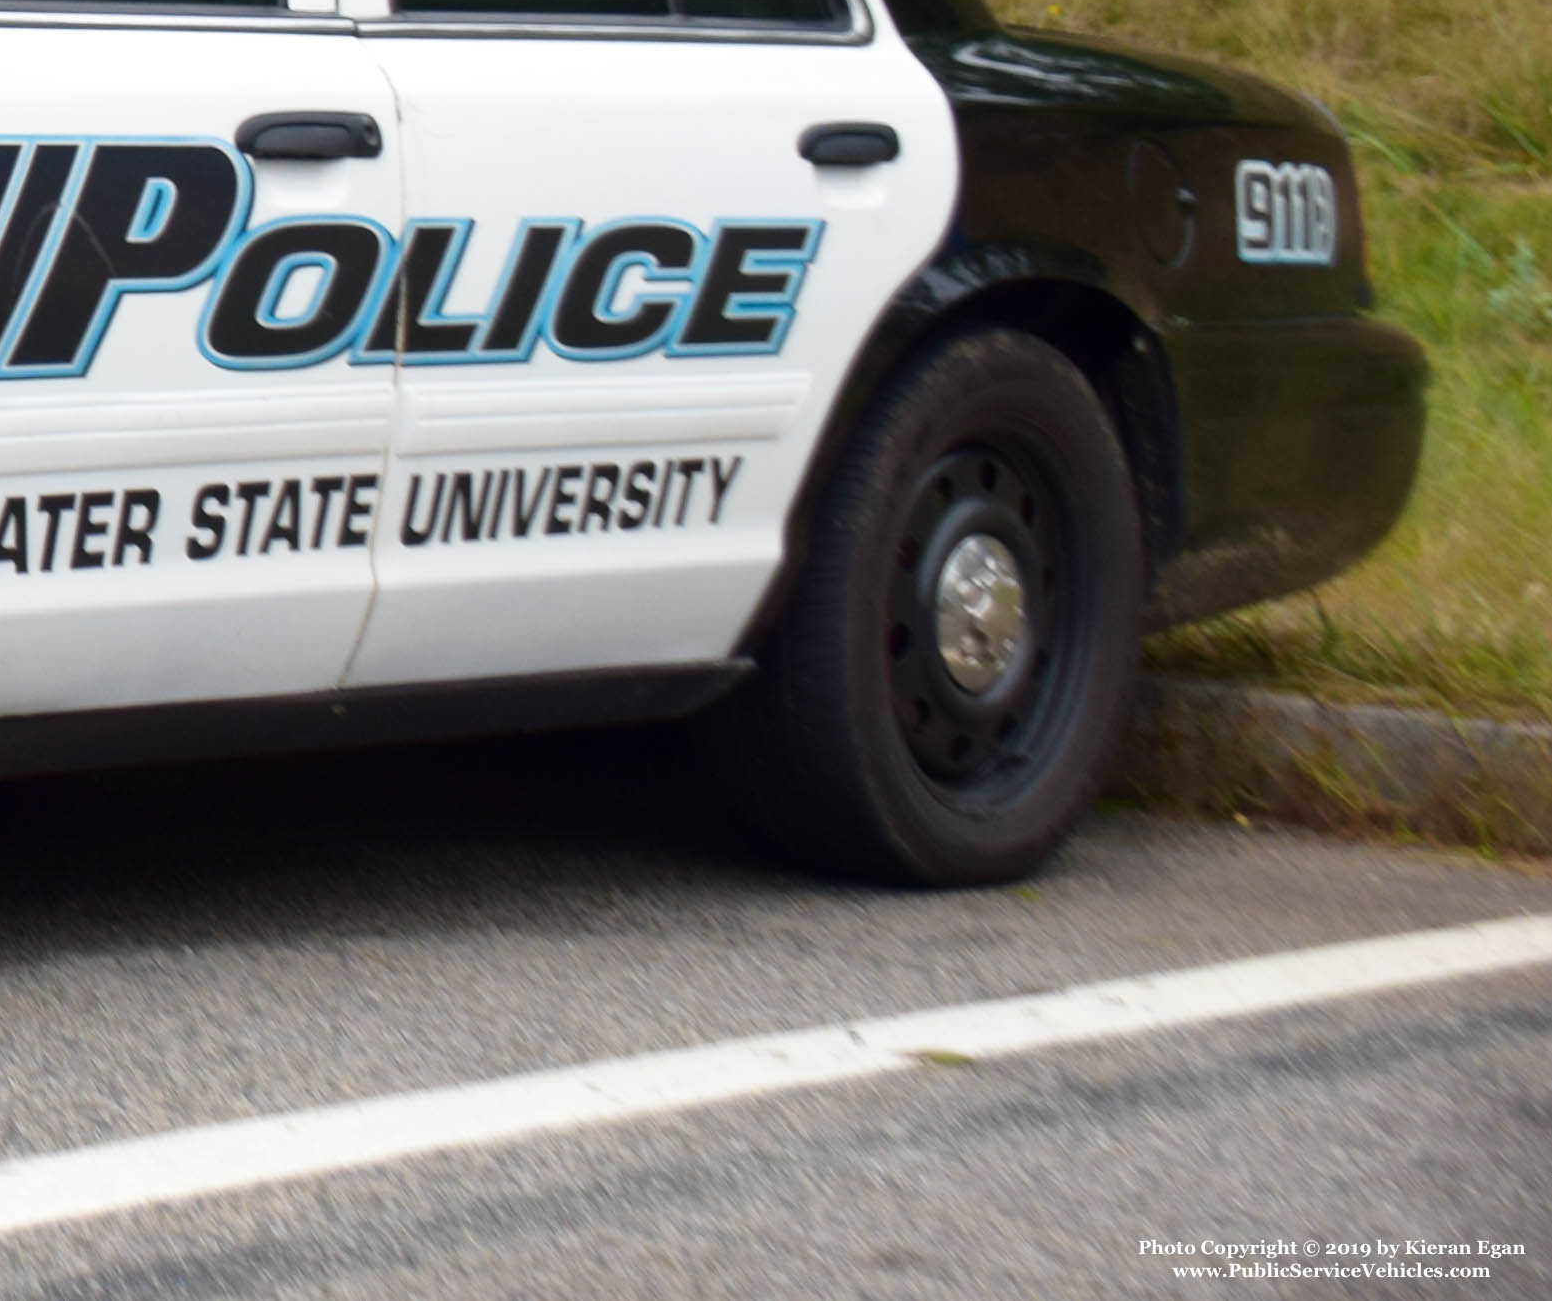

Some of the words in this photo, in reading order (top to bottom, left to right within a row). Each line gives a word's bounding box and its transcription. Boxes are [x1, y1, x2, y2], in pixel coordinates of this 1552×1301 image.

[1, 137, 824, 377] POLICE
[186, 474, 380, 561] STATE
[401, 456, 744, 547] UNIVERSITY
